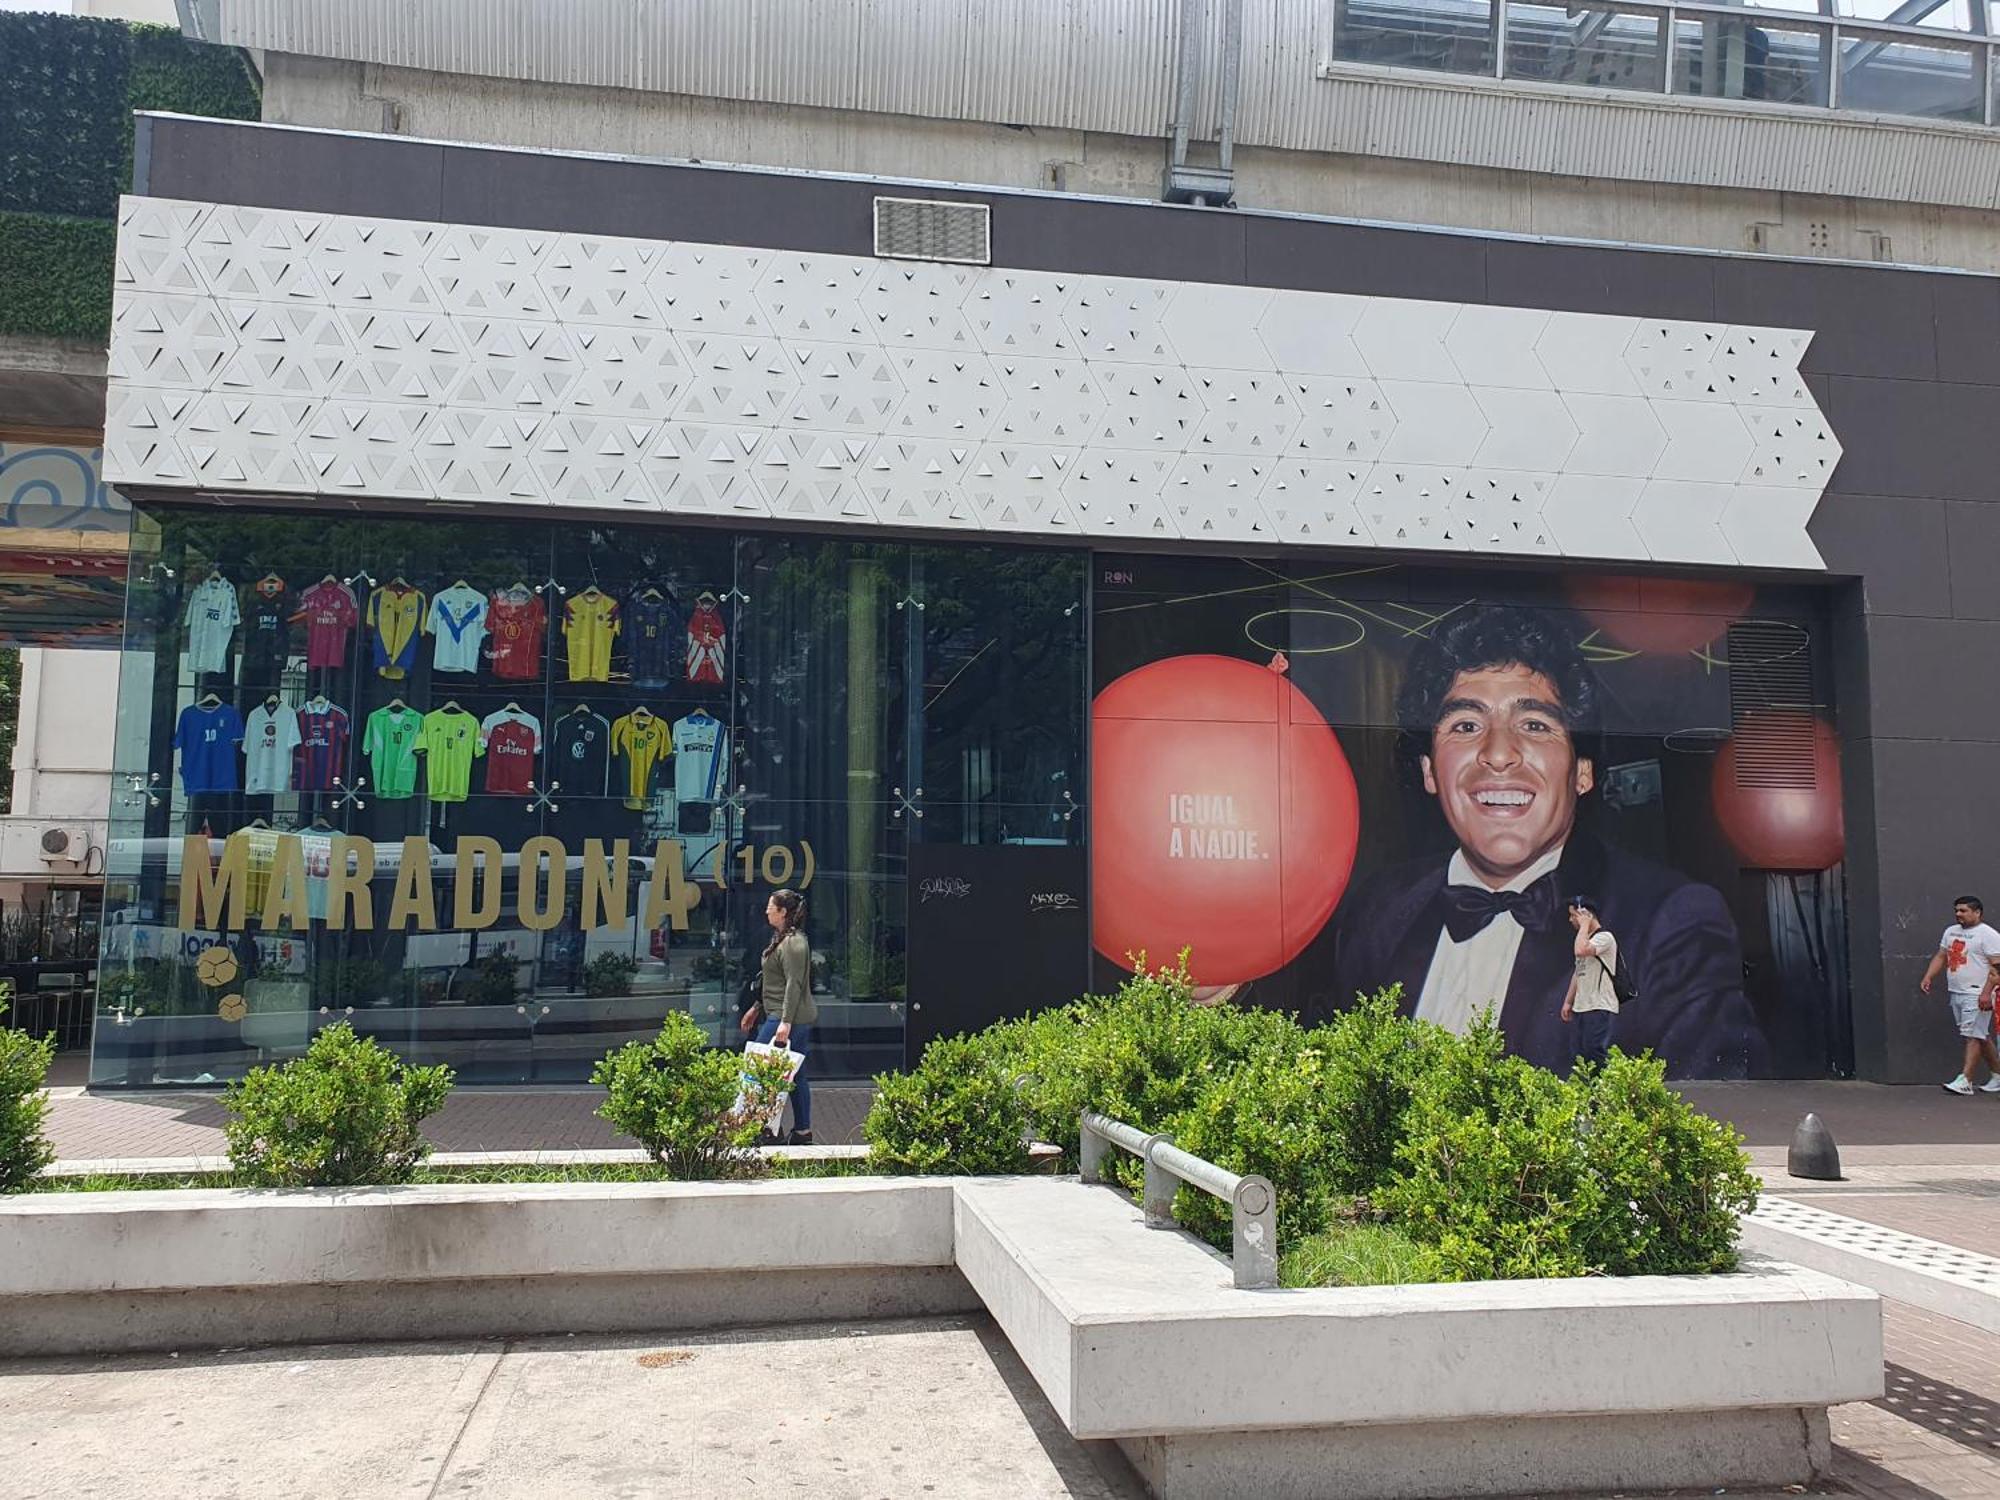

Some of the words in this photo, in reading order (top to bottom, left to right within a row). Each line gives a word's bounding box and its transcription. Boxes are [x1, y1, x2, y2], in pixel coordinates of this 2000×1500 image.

[1169, 794, 1237, 824] IGUAL
[1169, 827, 1184, 858] A
[1190, 829, 1269, 859] NADIE.
[178, 834, 689, 930] MARADONA
[713, 840, 815, 889] (10)
